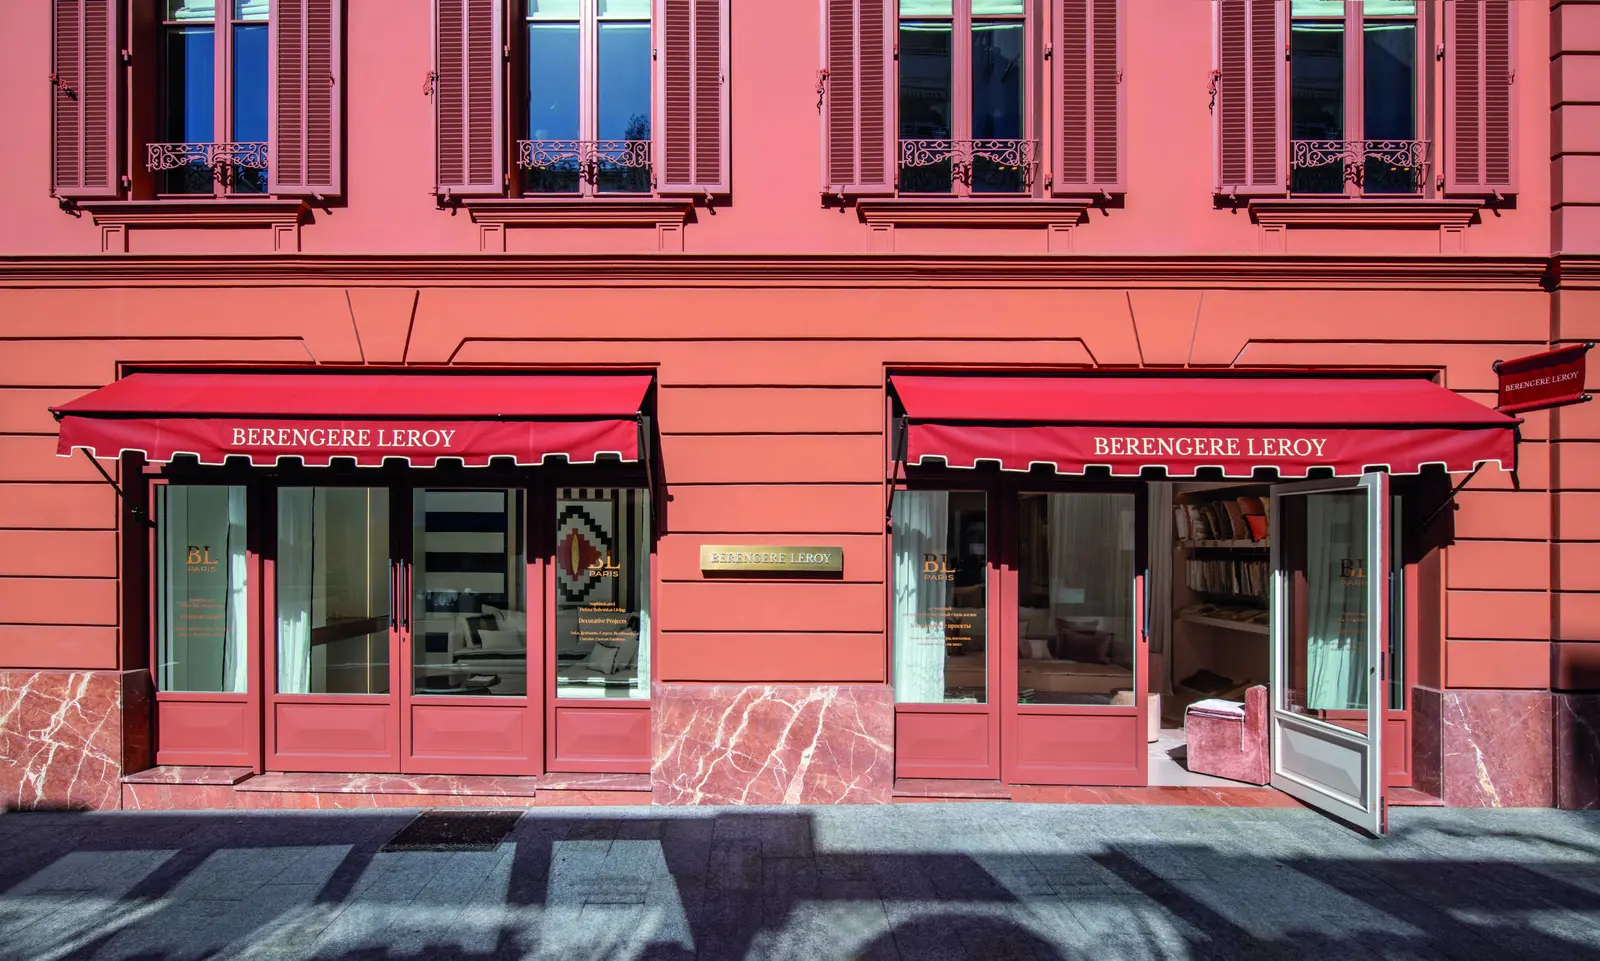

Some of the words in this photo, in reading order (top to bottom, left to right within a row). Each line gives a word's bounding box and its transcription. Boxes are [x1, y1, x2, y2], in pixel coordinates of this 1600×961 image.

[1505, 377, 1550, 392] BERENGERE
[1552, 371, 1579, 383] LEROY
[231, 427, 371, 447] BERENGERE
[377, 429, 456, 447] LEROY
[1094, 437, 1241, 456] BERENGERE
[1247, 438, 1327, 457] LEROY
[186, 545, 219, 565] BL
[711, 552, 786, 564] BERENGERE
[790, 553, 832, 564] LEROY
[922, 553, 956, 573] BL
[589, 570, 619, 578] PARIS
[606, 617, 628, 625] Projects
